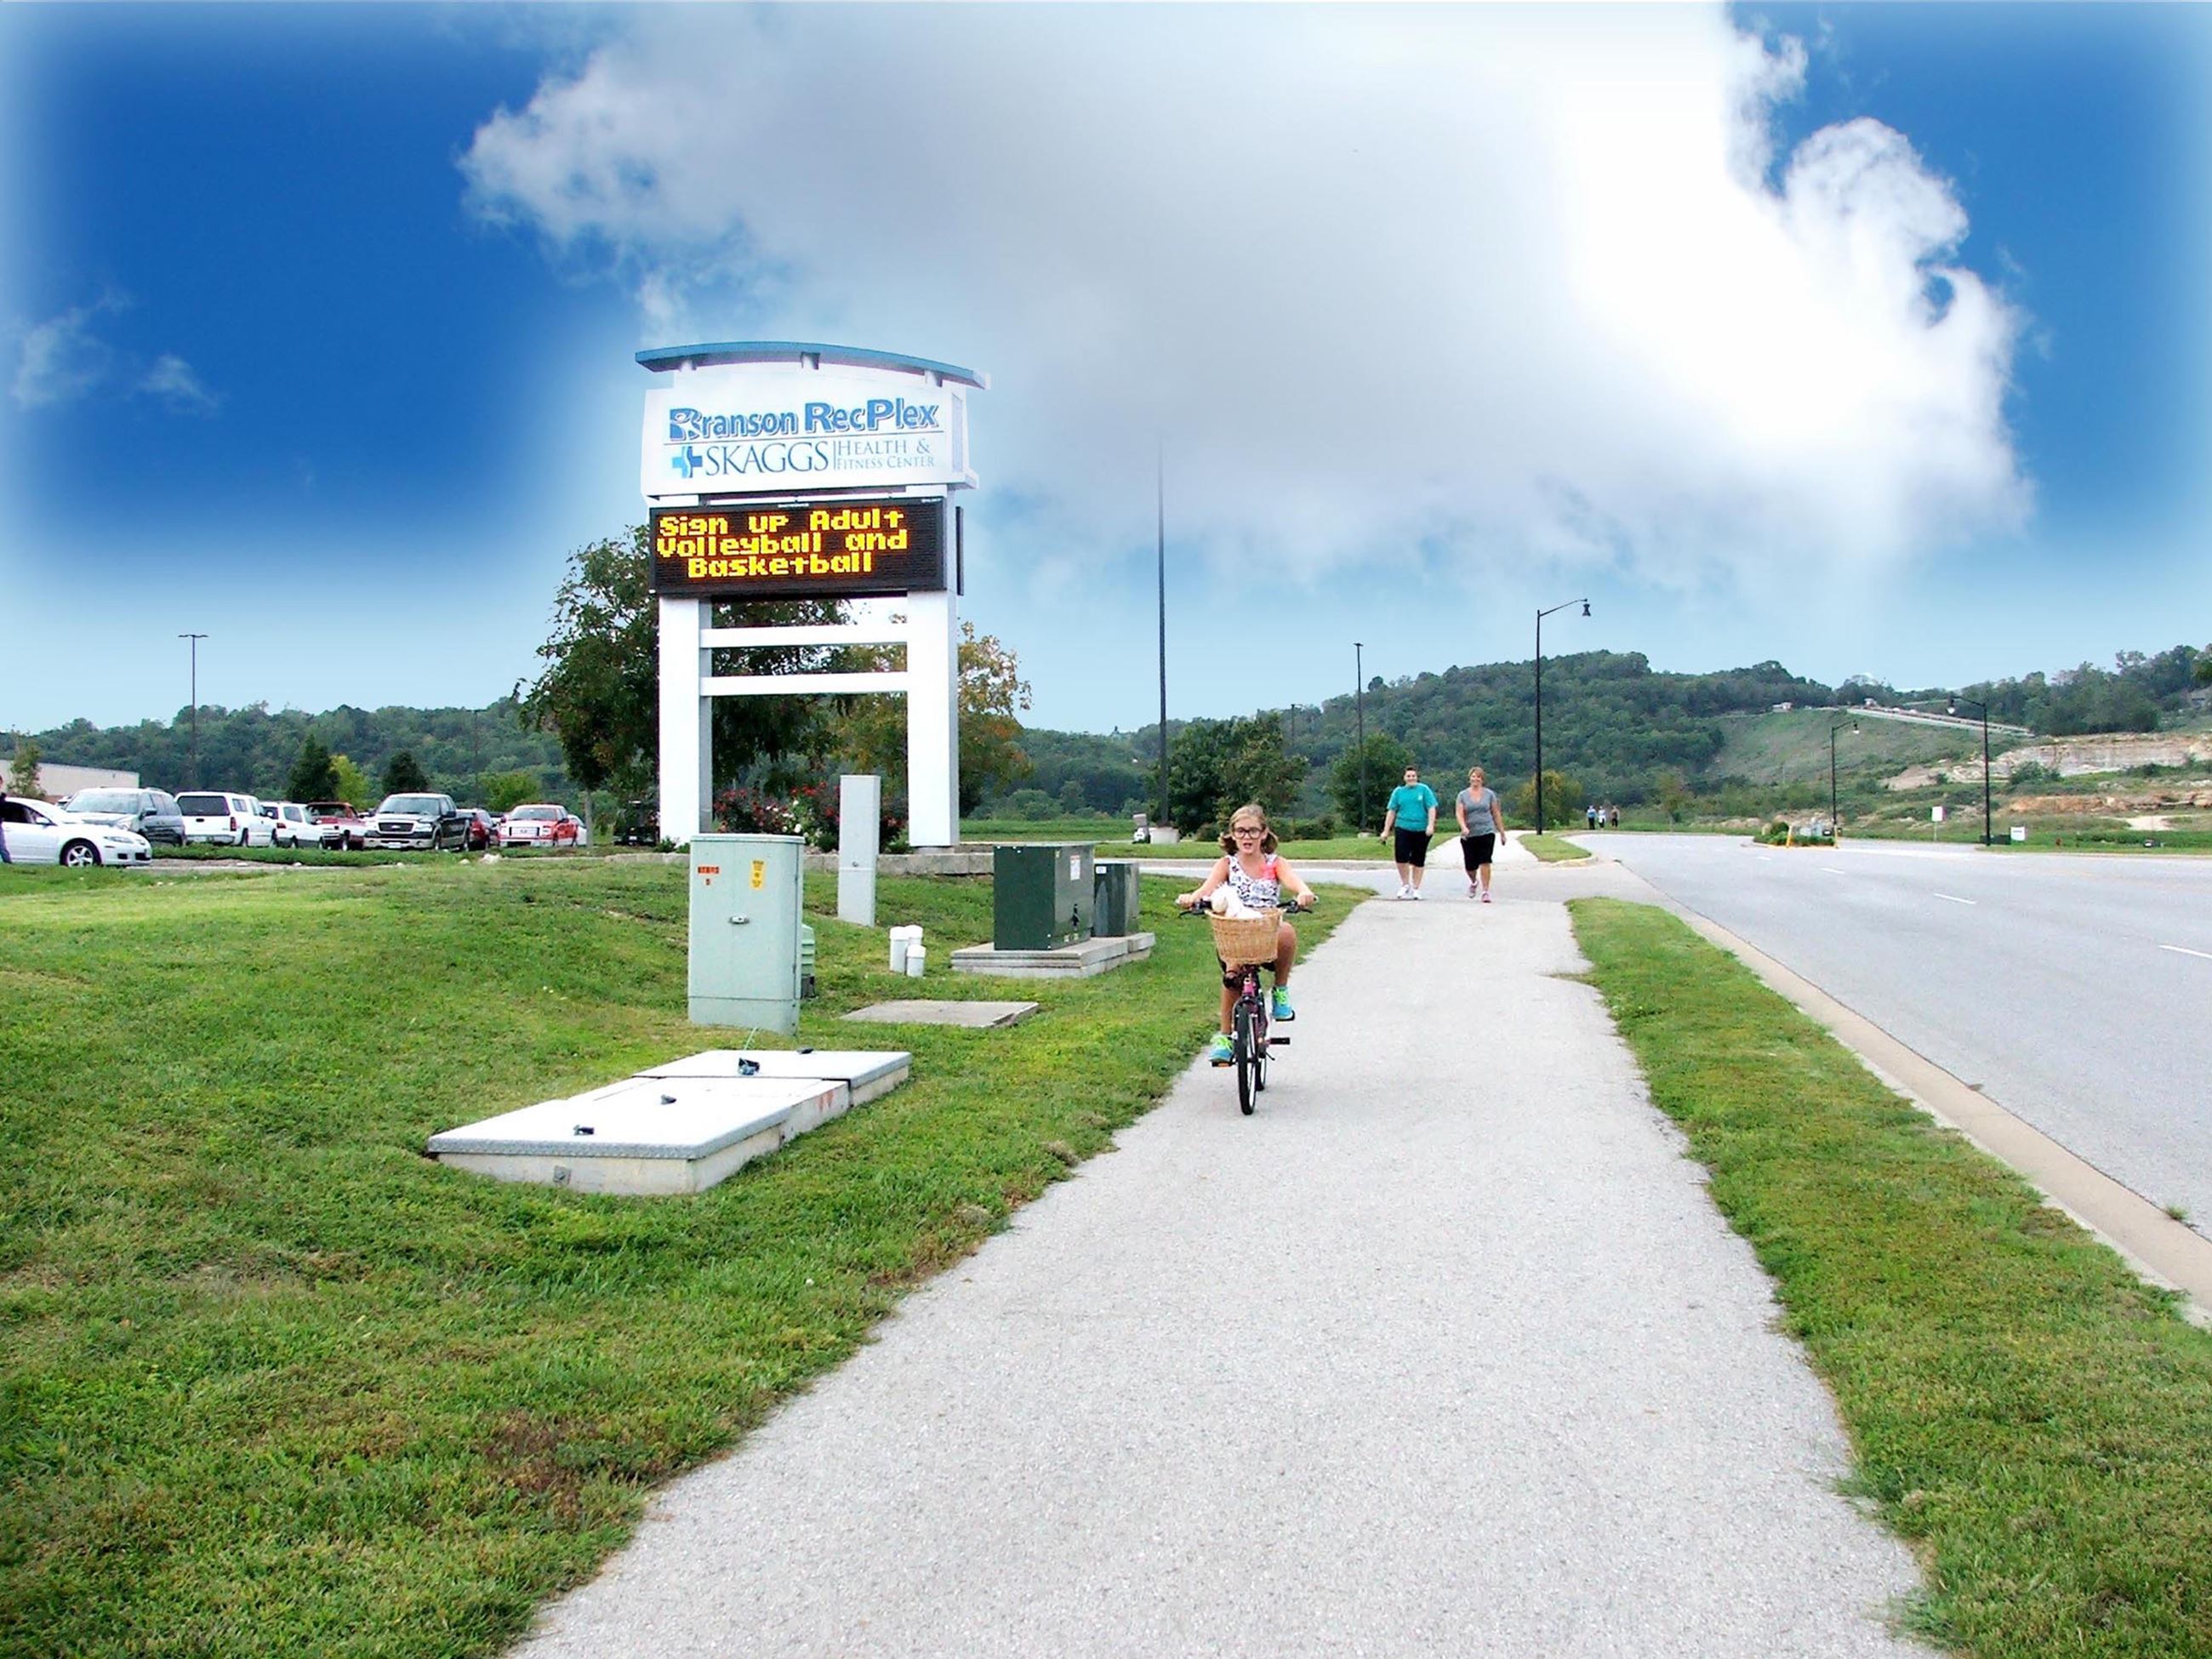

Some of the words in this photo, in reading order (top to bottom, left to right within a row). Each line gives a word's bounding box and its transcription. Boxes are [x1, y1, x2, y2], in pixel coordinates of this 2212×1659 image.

[670, 408, 799, 441] Branson
[805, 397, 939, 434] RecPlex
[705, 441, 829, 476] SKAGGS
[838, 438, 907, 456] HEALTH
[915, 437, 931, 454] &
[837, 458, 883, 470] FITNESS
[887, 455, 935, 469] CENTER
[659, 516, 728, 537] Sign
[810, 508, 904, 531] Adult
[657, 533, 821, 558] Volleyball
[845, 528, 908, 551] and
[687, 551, 872, 579] Basketball
